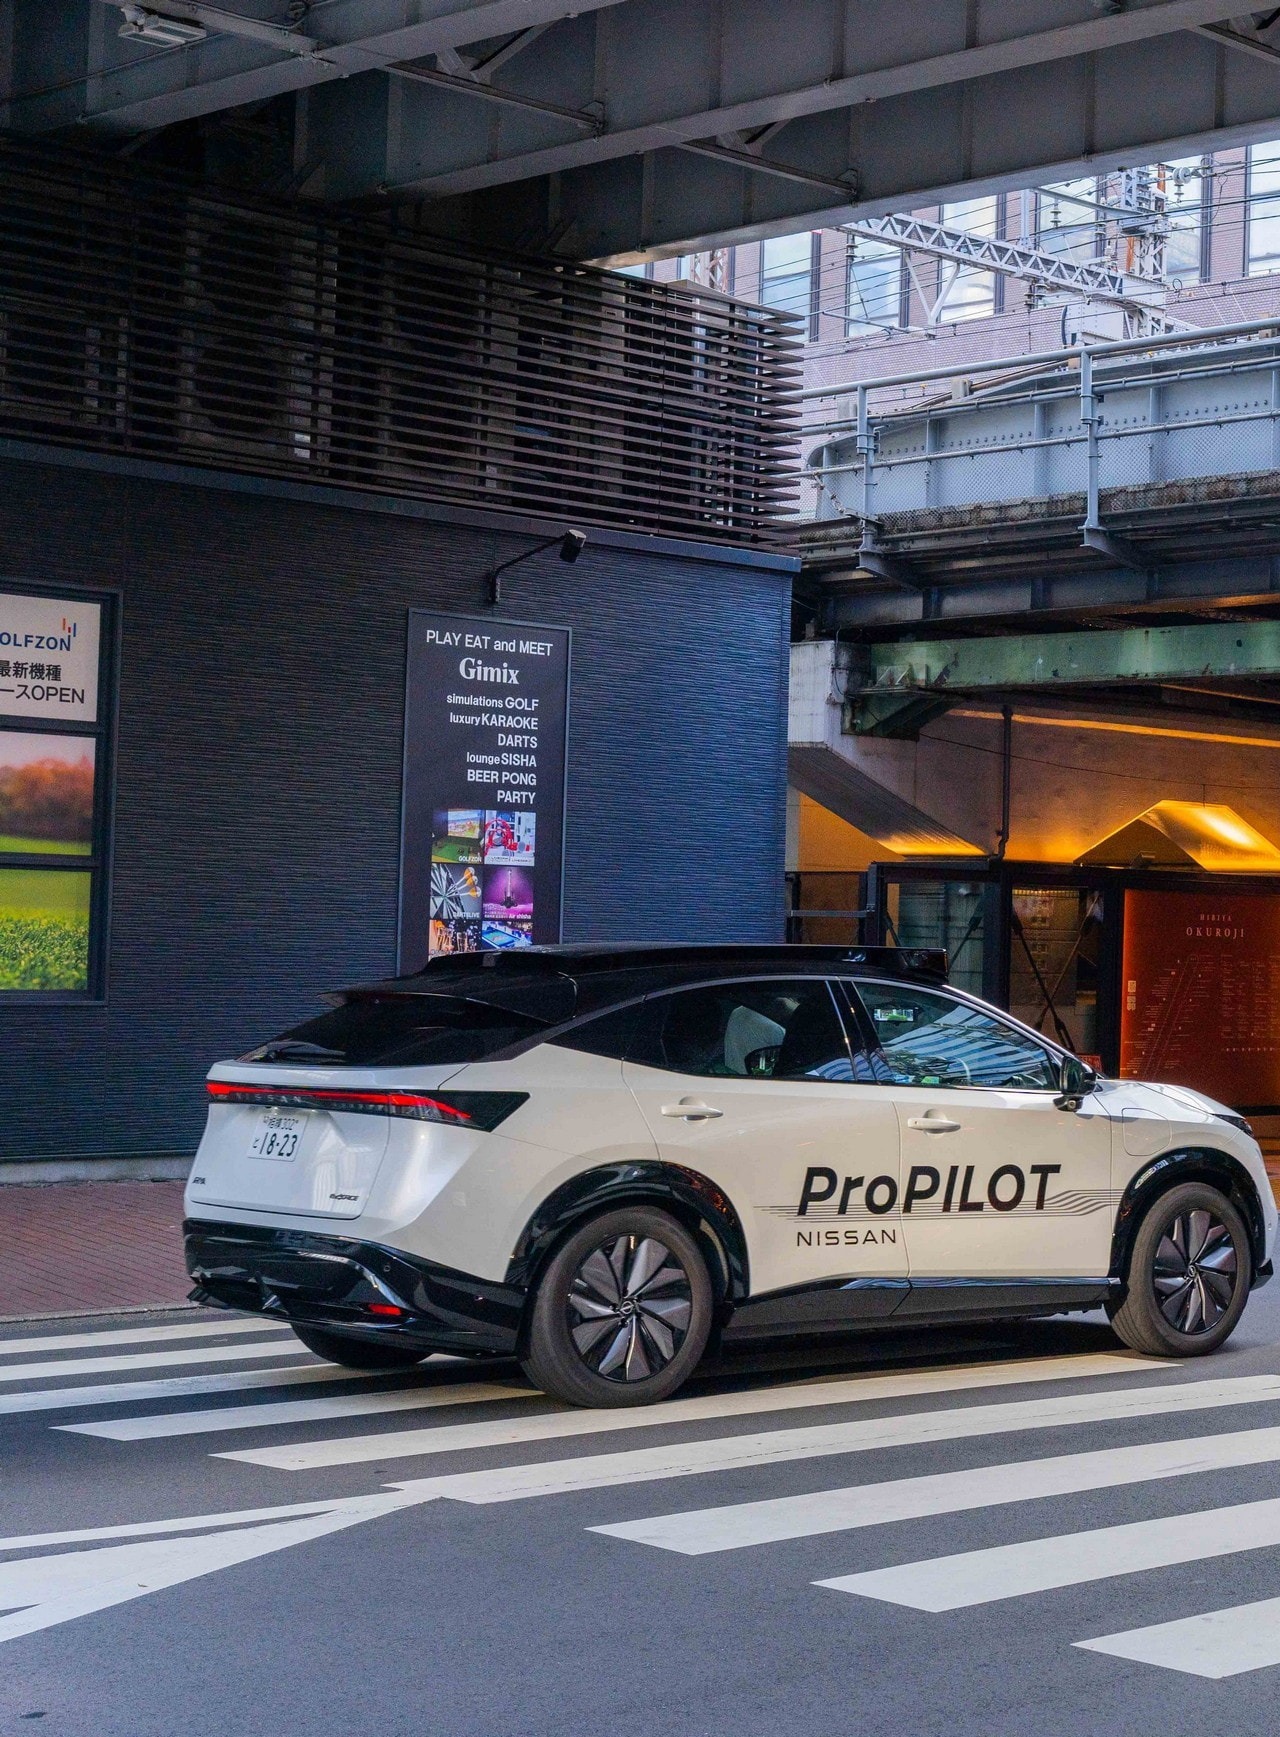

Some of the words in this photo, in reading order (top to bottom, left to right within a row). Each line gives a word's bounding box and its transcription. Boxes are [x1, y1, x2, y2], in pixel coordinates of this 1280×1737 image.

[426, 629, 462, 647] PLAY
[464, 634, 491, 650] EAT
[493, 639, 517, 653] and
[519, 639, 554, 657] MEET
[458, 656, 520, 685] Gimix
[446, 693, 504, 709] simulations
[505, 696, 540, 711] GOLF
[449, 712, 481, 726] luxury
[481, 713, 539, 730] KARAOKE
[497, 733, 538, 749] DARTS
[466, 752, 500, 766] lounge
[501, 753, 537, 768] SISHA
[467, 769, 499, 784] BEER
[501, 771, 537, 786] PONG
[497, 790, 536, 805] PARTY
[1185, 926, 1245, 939] OKUROJI
[796, 1163, 1062, 1217] ProPILOT
[796, 1228, 897, 1247] NISSAN
